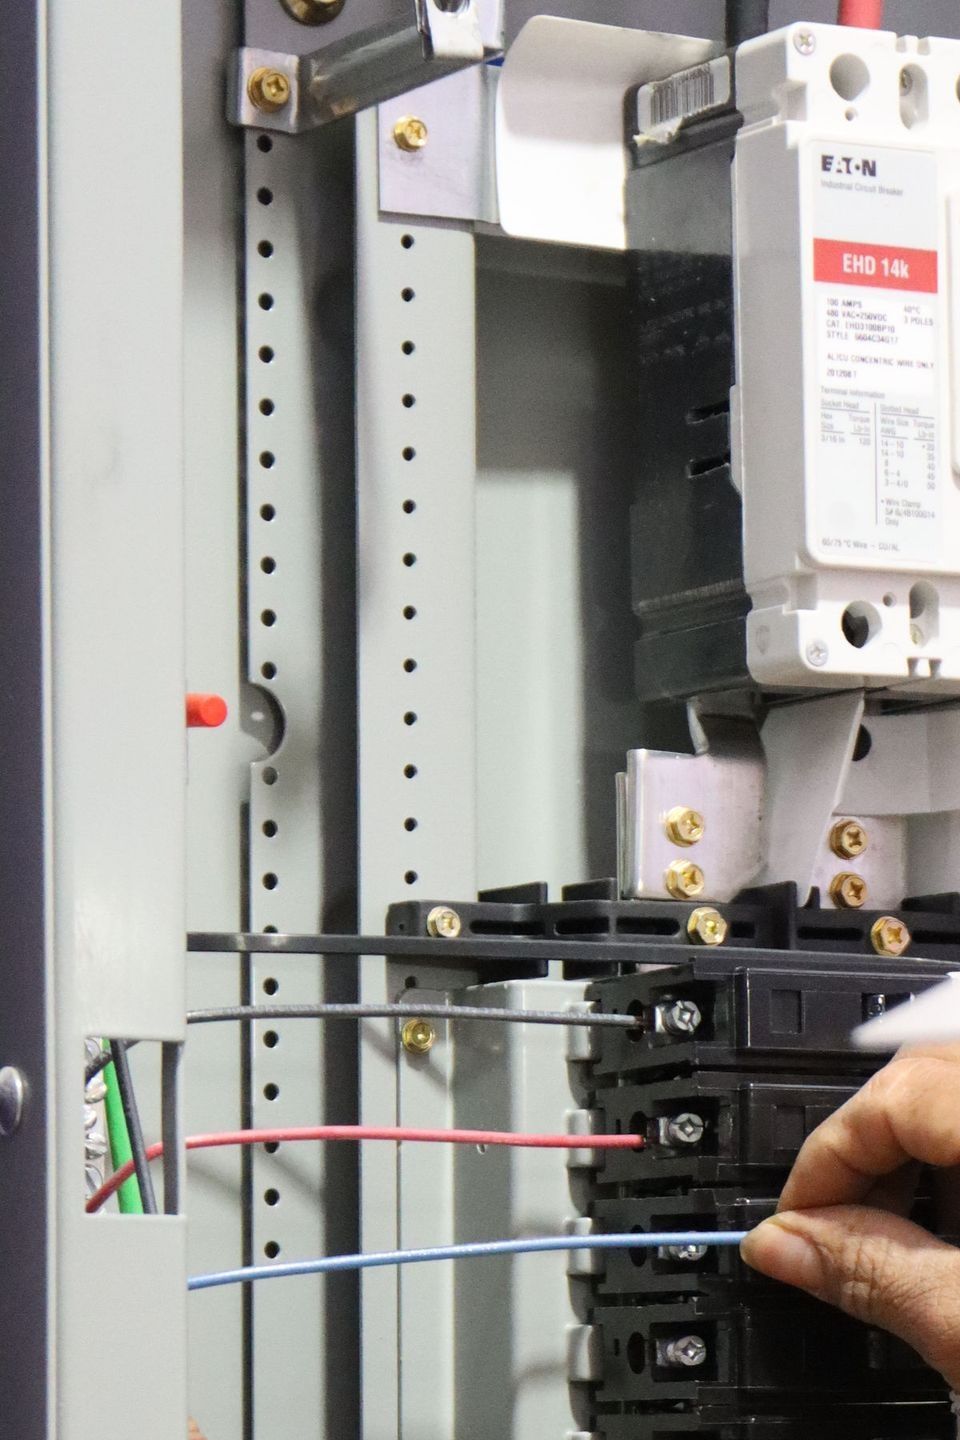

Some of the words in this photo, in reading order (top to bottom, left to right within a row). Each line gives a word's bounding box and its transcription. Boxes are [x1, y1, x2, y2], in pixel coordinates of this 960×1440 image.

[821, 179, 854, 191] Industrial
[854, 183, 878, 193] Circuit
[878, 185, 904, 196] Breaker
[842, 253, 877, 276] EHD
[881, 257, 910, 279] 14k
[842, 299, 863, 309] AMPS
[910, 317, 934, 327] POLES
[826, 331, 848, 341] STYLE
[850, 355, 894, 367] CONCENTRIC
[917, 360, 935, 369] ONLY
